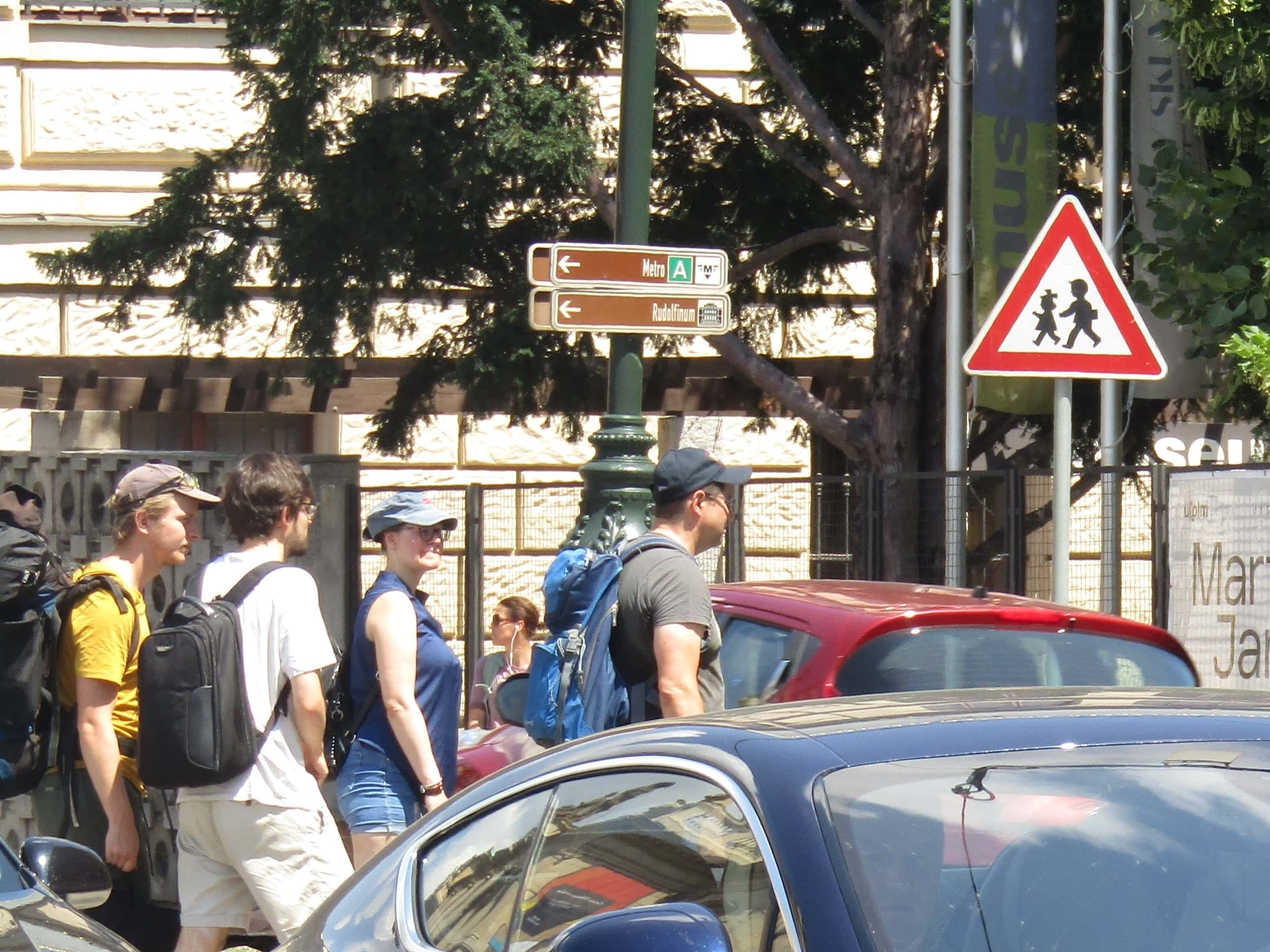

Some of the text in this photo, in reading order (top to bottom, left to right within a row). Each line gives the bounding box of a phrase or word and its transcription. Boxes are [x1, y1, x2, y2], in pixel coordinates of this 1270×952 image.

[642, 258, 665, 278] Metro
[672, 260, 688, 279] A
[652, 303, 696, 322] Rudolfinum
